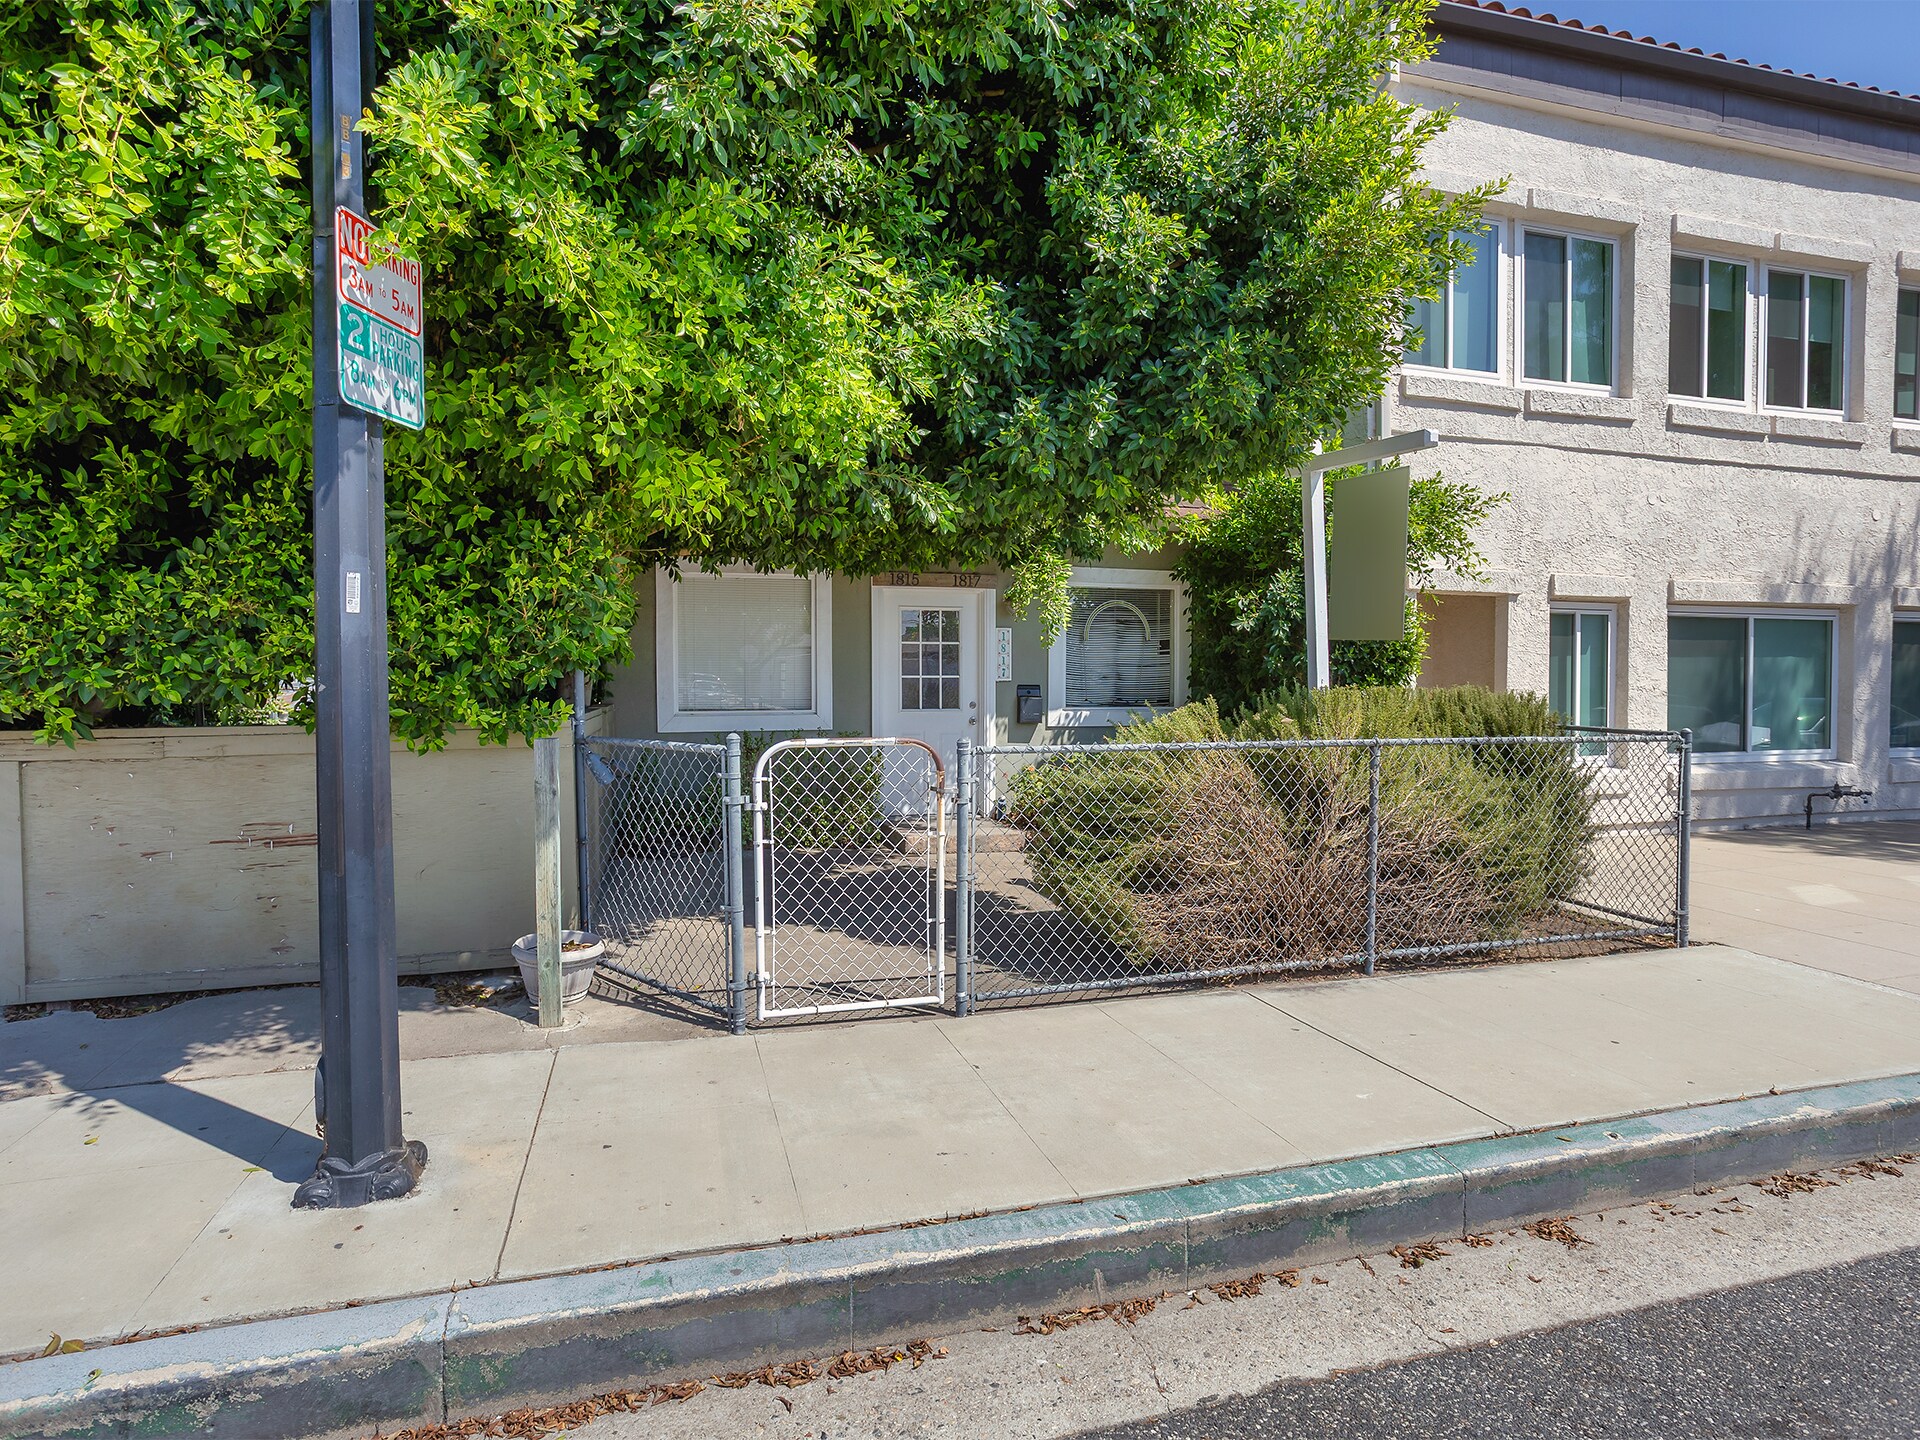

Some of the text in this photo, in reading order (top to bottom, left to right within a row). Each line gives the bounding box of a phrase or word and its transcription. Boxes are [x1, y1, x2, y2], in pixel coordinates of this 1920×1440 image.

[340, 211, 365, 260] NO
[370, 244, 416, 286] RKING
[349, 265, 414, 320] 3AM TO 5AM
[347, 312, 364, 351] 2
[380, 327, 411, 356] HOUR
[373, 341, 418, 382] PARKING
[394, 380, 416, 407] 6PM
[889, 572, 981, 588] 1815 1817
